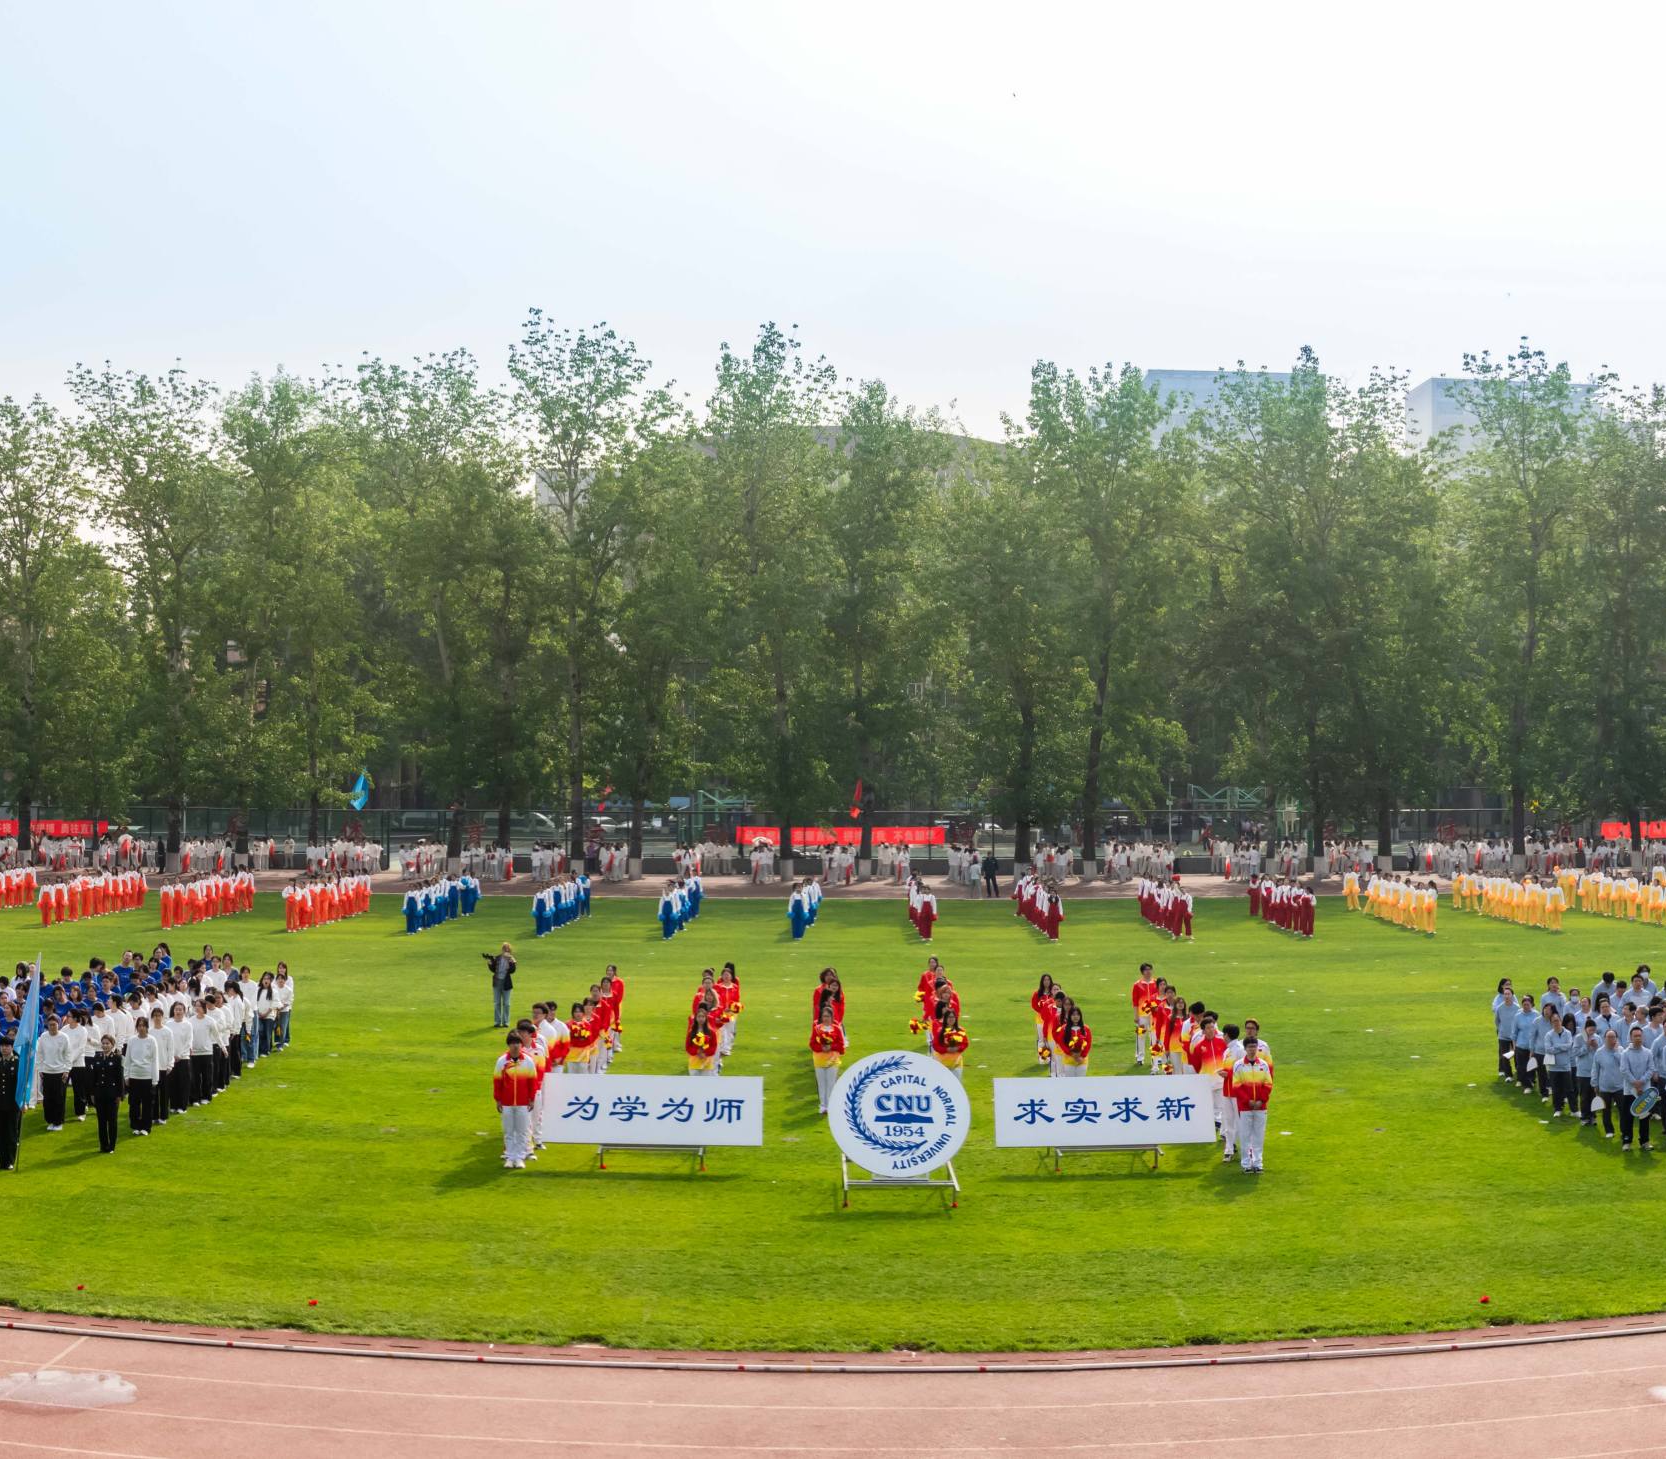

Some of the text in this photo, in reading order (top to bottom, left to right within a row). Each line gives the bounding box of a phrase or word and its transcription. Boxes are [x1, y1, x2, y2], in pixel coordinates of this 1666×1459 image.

[564, 1095, 745, 1123] 为学为师
[874, 1093, 933, 1113] CNU
[1014, 1096, 1196, 1125] 求实求新
[880, 1074, 957, 1170] CAPITAL NORMAL UNIVERSITY
[883, 1125, 925, 1138] 1954
